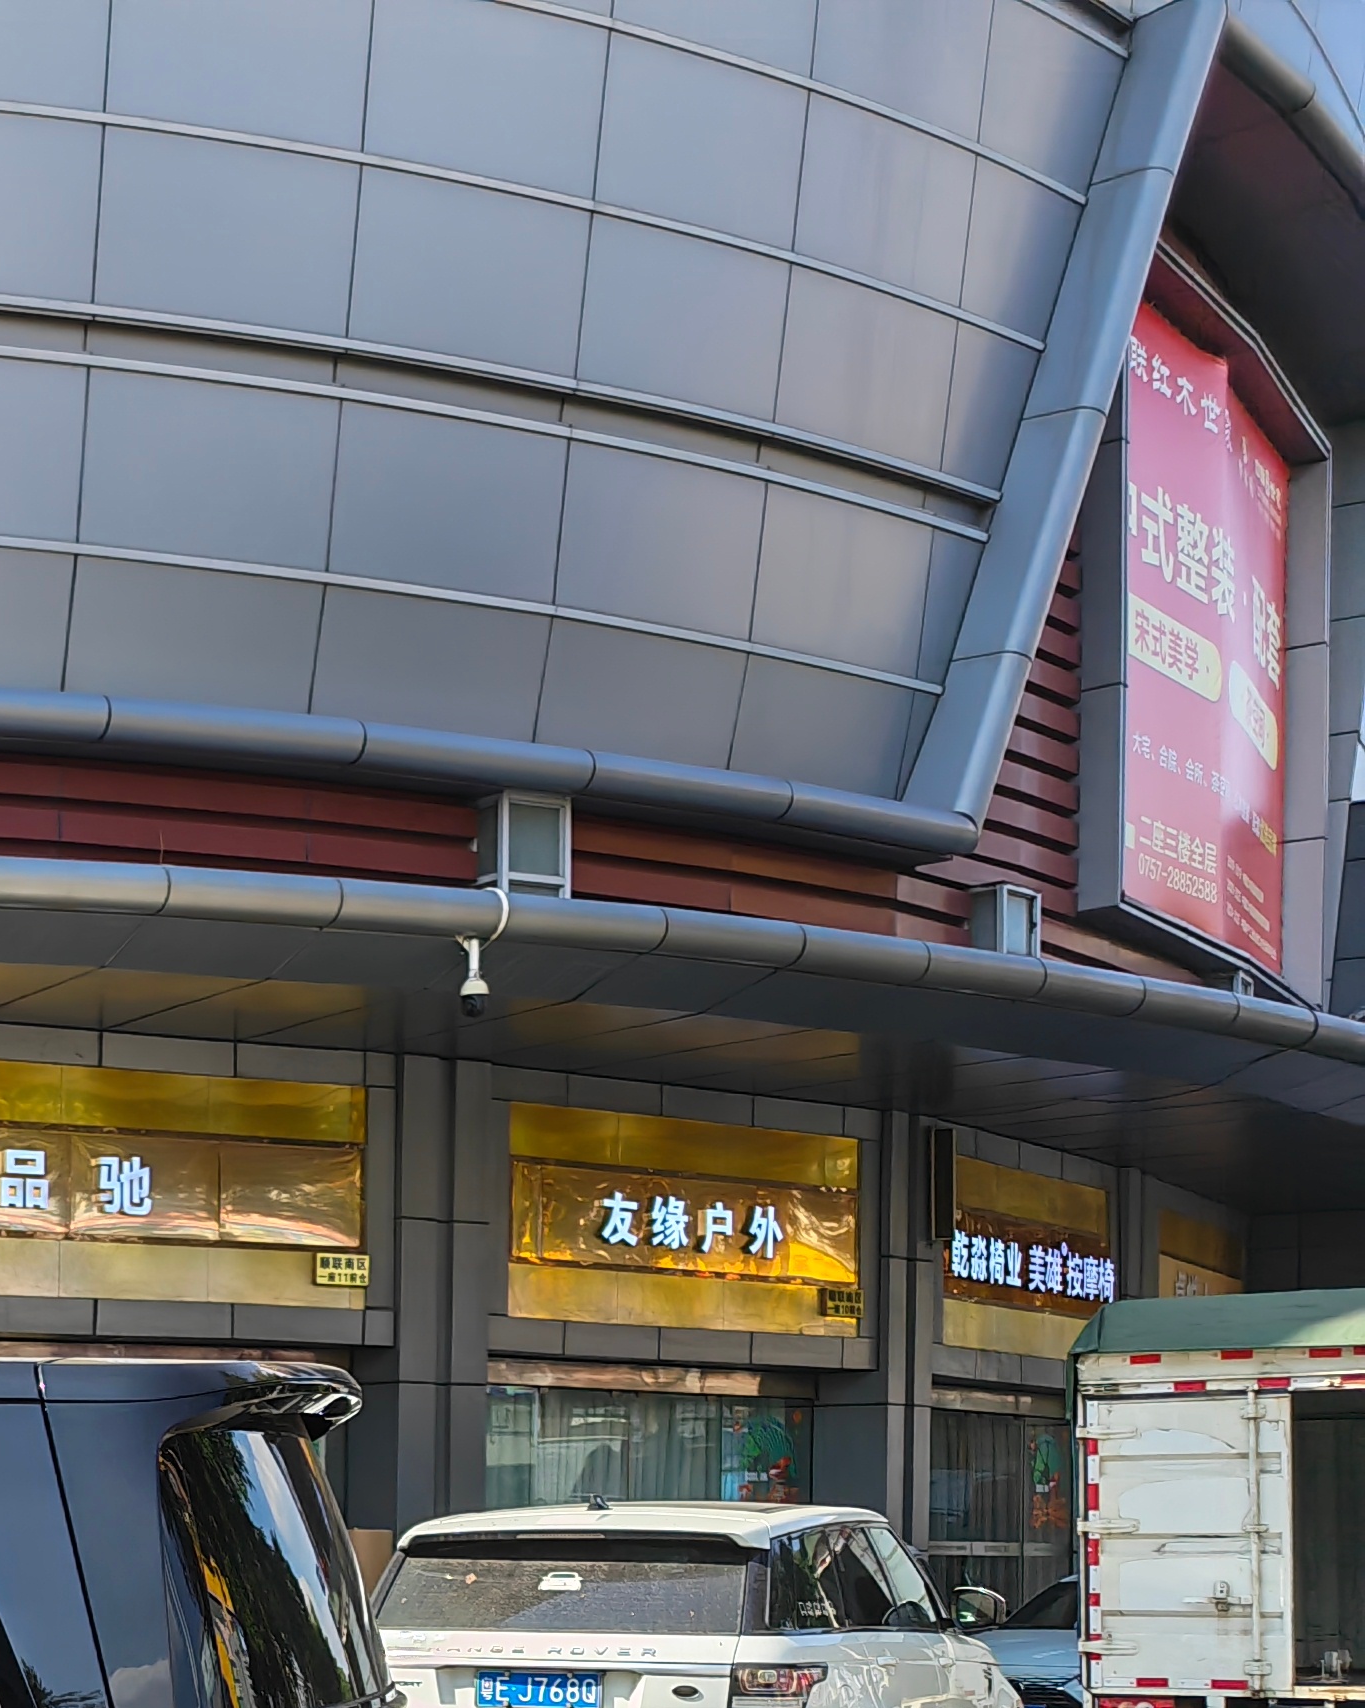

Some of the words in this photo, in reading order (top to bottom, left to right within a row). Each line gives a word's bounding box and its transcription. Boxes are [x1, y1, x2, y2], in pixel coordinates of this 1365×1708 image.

[1138, 853, 1218, 904] 0757-28852588
[601, 1191, 784, 1259] 友缘户外
[548, 1646, 657, 1658] ROVER
